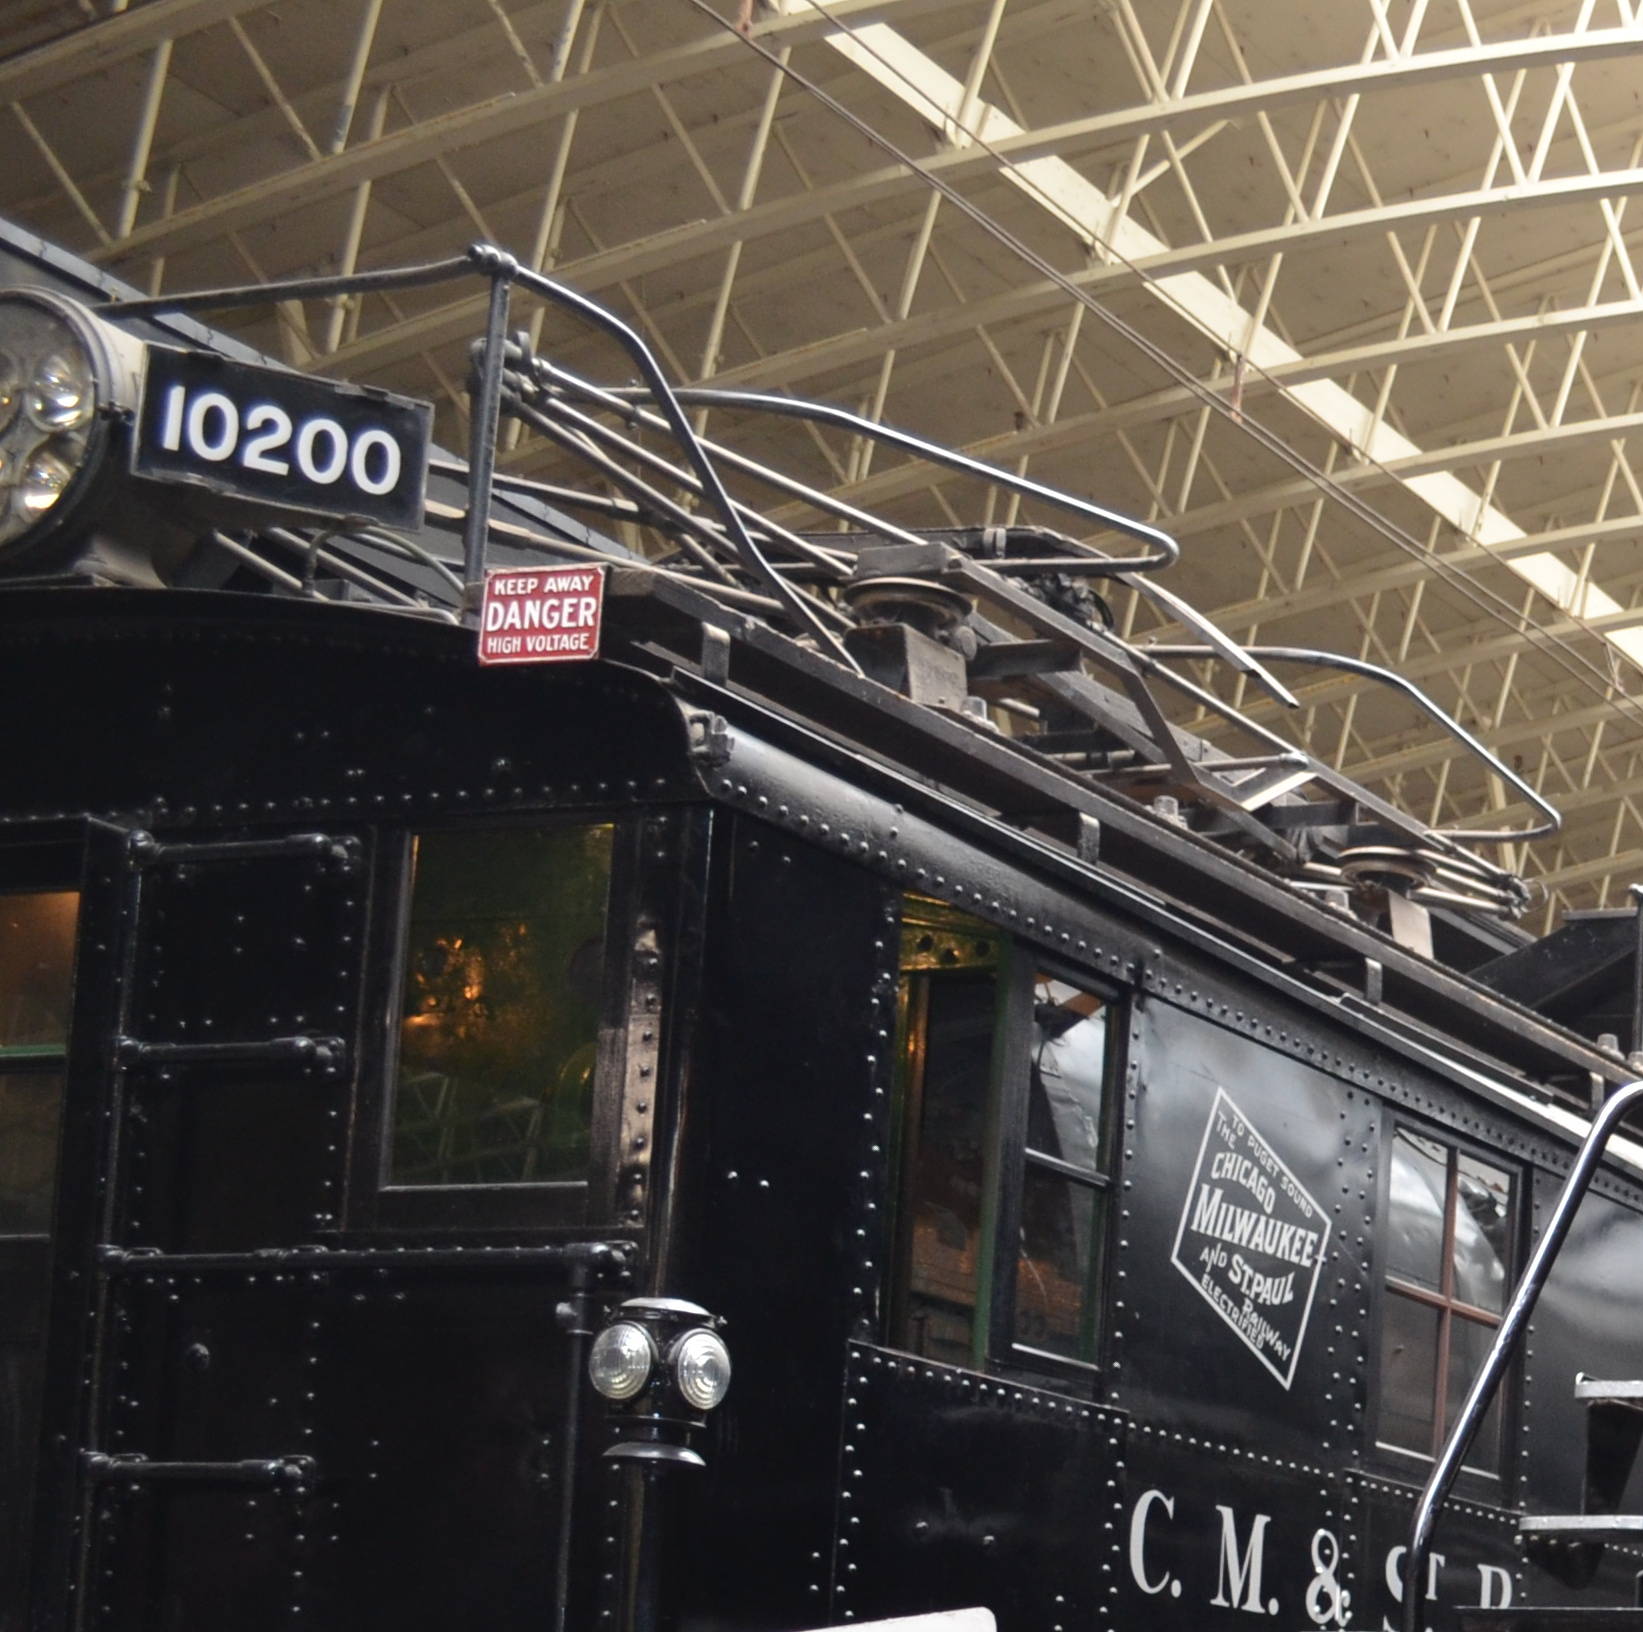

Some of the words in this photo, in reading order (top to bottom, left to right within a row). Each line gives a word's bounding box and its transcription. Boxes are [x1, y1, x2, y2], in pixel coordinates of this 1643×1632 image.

[161, 384, 402, 497] 10200
[486, 599, 598, 634] DANGER
[493, 577, 543, 596] KEEP
[547, 574, 595, 594] AWAY
[487, 635, 525, 653] HIGH
[527, 631, 591, 654] VOLTAGE
[1214, 1110, 1237, 1150] THE
[1210, 1152, 1277, 1215] CHICAGO
[1231, 1114, 1245, 1138] TO
[1247, 1134, 1281, 1180] PUGET
[1280, 1176, 1314, 1219] SOUND
[1190, 1182, 1319, 1268] MILWAUKEE
[1199, 1242, 1229, 1272] AND
[1200, 1272, 1265, 1351] ELECTRIFIED
[1241, 1297, 1292, 1363] RAILWAY
[1305, 1527, 1352, 1628] &
